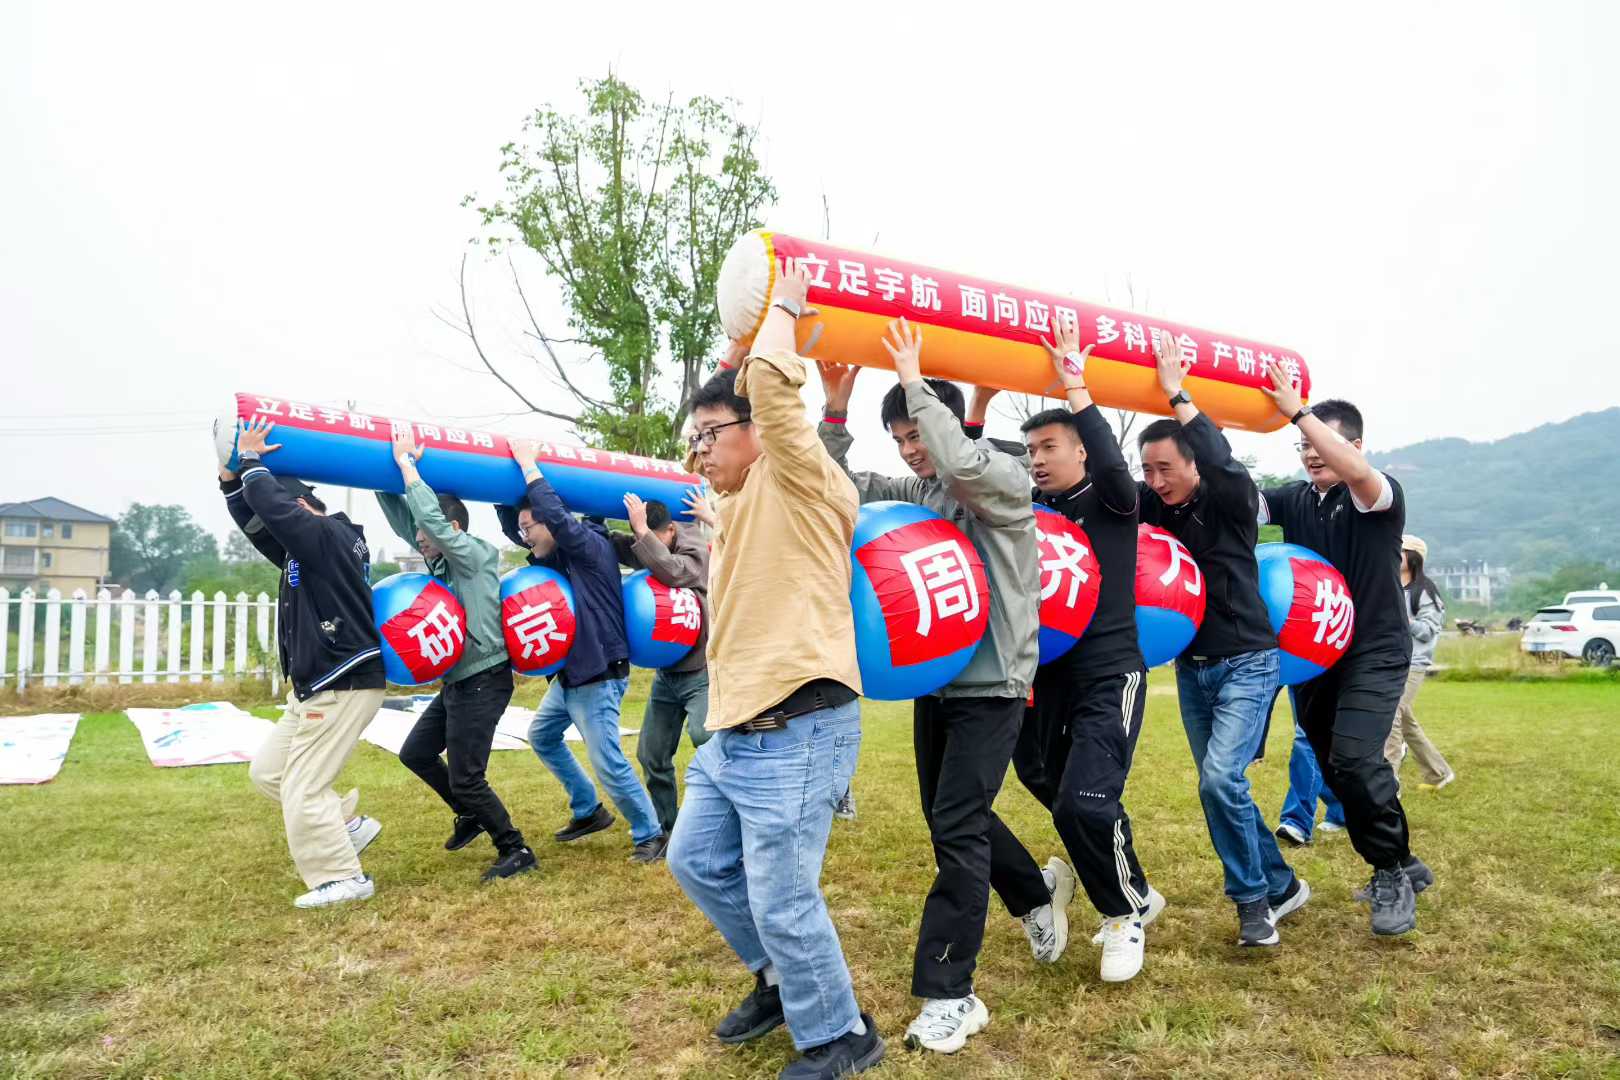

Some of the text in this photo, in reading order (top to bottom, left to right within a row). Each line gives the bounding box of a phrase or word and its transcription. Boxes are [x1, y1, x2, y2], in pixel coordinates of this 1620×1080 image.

[799, 253, 942, 311] 立足宇航
[255, 397, 376, 431] 立足宇航
[392, 421, 495, 448] 向应用
[900, 539, 980, 637] 周
[1035, 528, 1089, 609] 济
[1150, 533, 1201, 596] 万
[407, 600, 465, 667] 研
[507, 601, 568, 660] 京
[1312, 578, 1354, 650] 物
